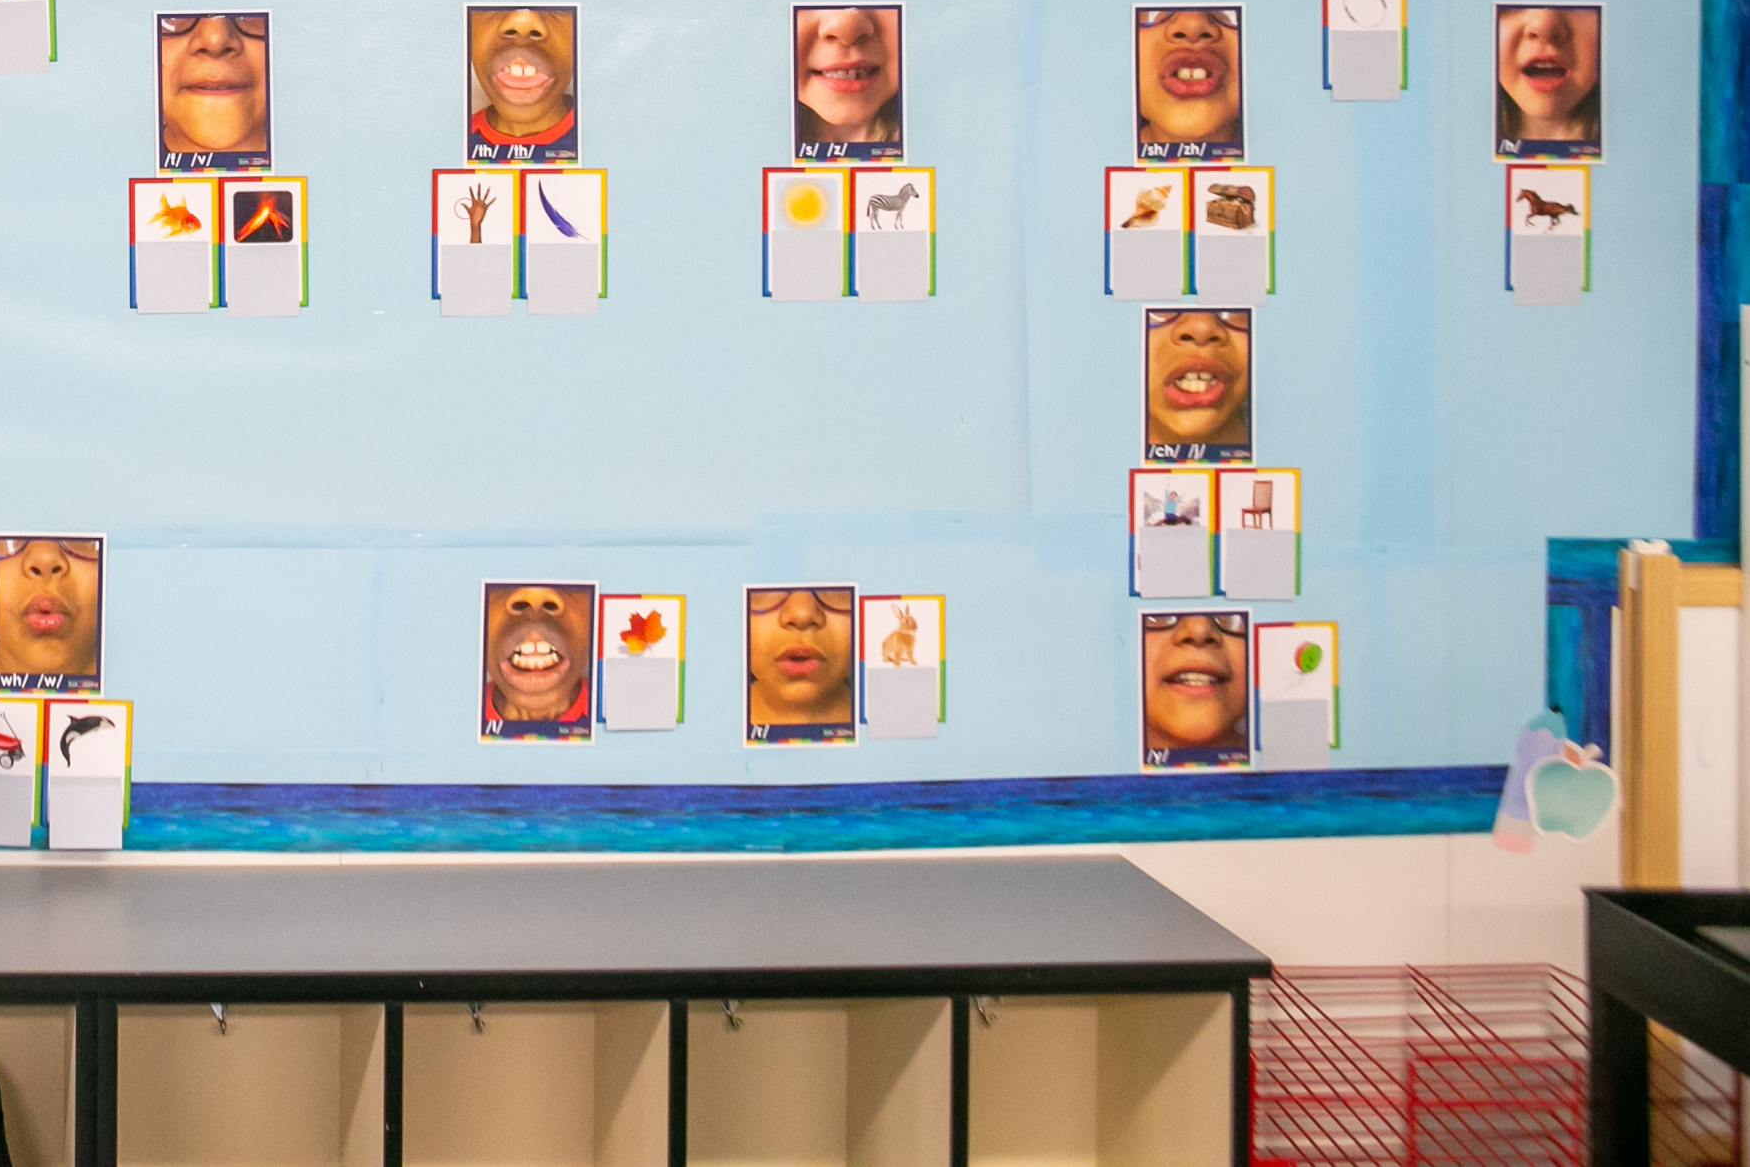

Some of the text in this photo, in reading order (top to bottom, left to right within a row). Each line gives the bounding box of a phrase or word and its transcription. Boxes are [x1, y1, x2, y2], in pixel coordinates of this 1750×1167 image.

[471, 144, 499, 159] /th/
[507, 144, 535, 159] /th/
[799, 142, 848, 157] /s/ /z/
[1141, 143, 1169, 157] /sh/
[1177, 142, 1206, 157] /zh/
[164, 152, 213, 167] /f/ /v/
[1148, 444, 1180, 458] /ch/
[37, 673, 63, 689] /w/
